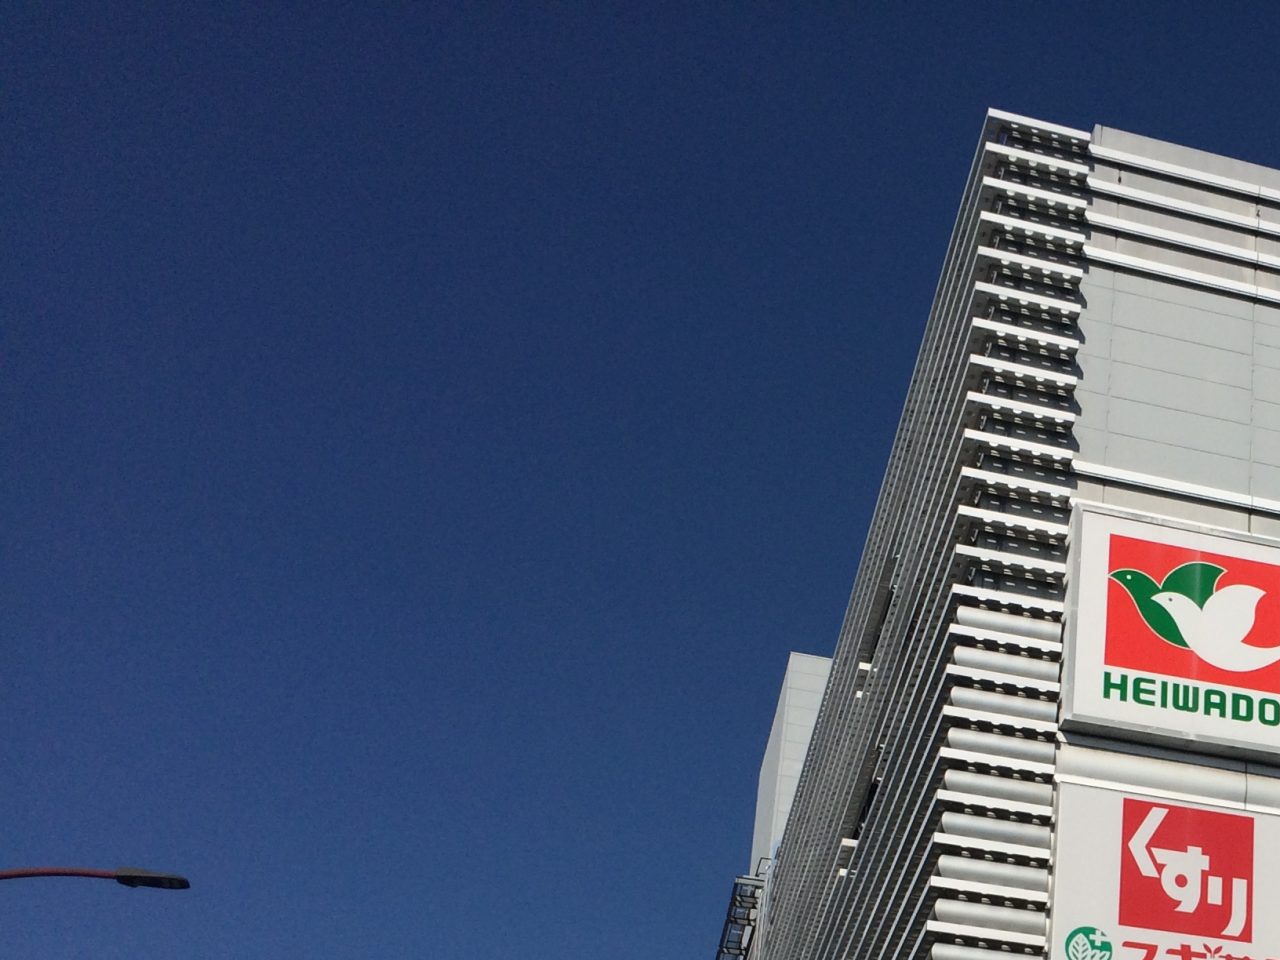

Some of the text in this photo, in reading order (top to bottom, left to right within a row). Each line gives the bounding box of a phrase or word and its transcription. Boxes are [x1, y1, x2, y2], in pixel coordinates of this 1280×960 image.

[1103, 671, 1280, 727] HEIWADO
[1127, 806, 1248, 937] くすり
